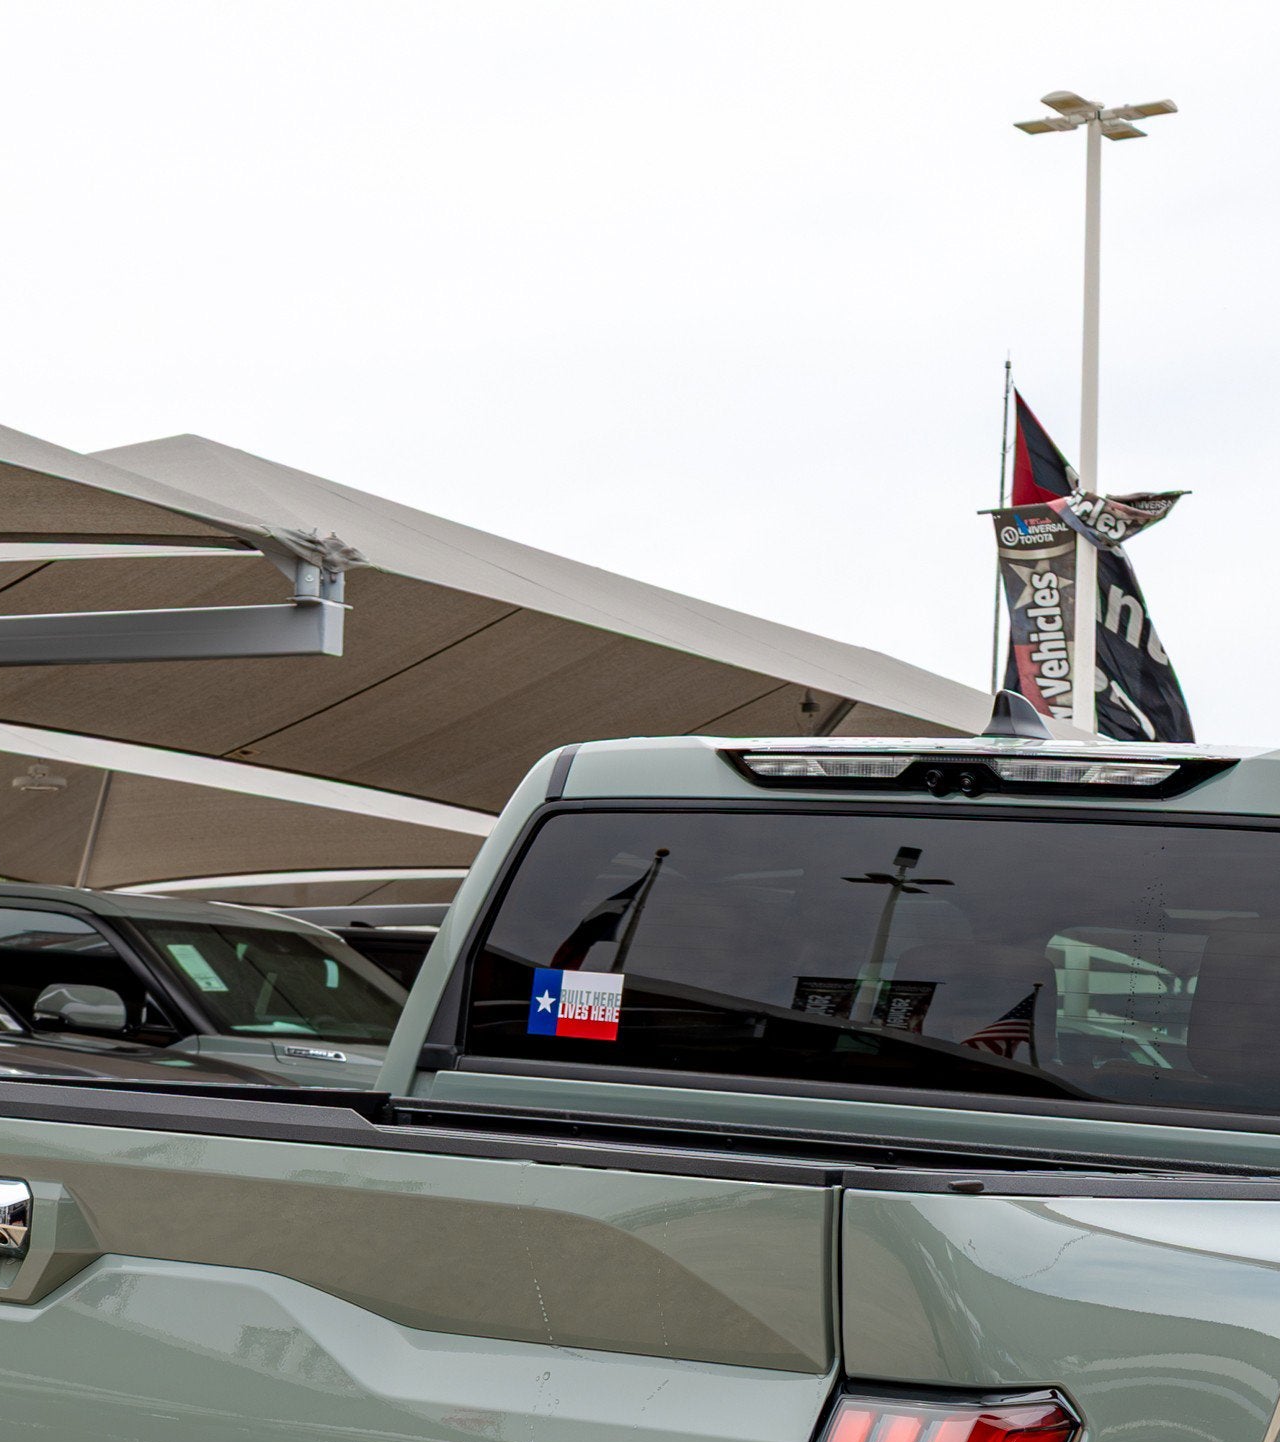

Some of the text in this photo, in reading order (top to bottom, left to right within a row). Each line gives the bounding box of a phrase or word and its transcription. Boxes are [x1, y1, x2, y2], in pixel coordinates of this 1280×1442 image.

[1020, 532, 1054, 545] TOYOTA
[1026, 571, 1072, 699] Vehicles
[561, 988, 622, 1008] BUILT HERE
[558, 1003, 620, 1023] LIVES HERE
